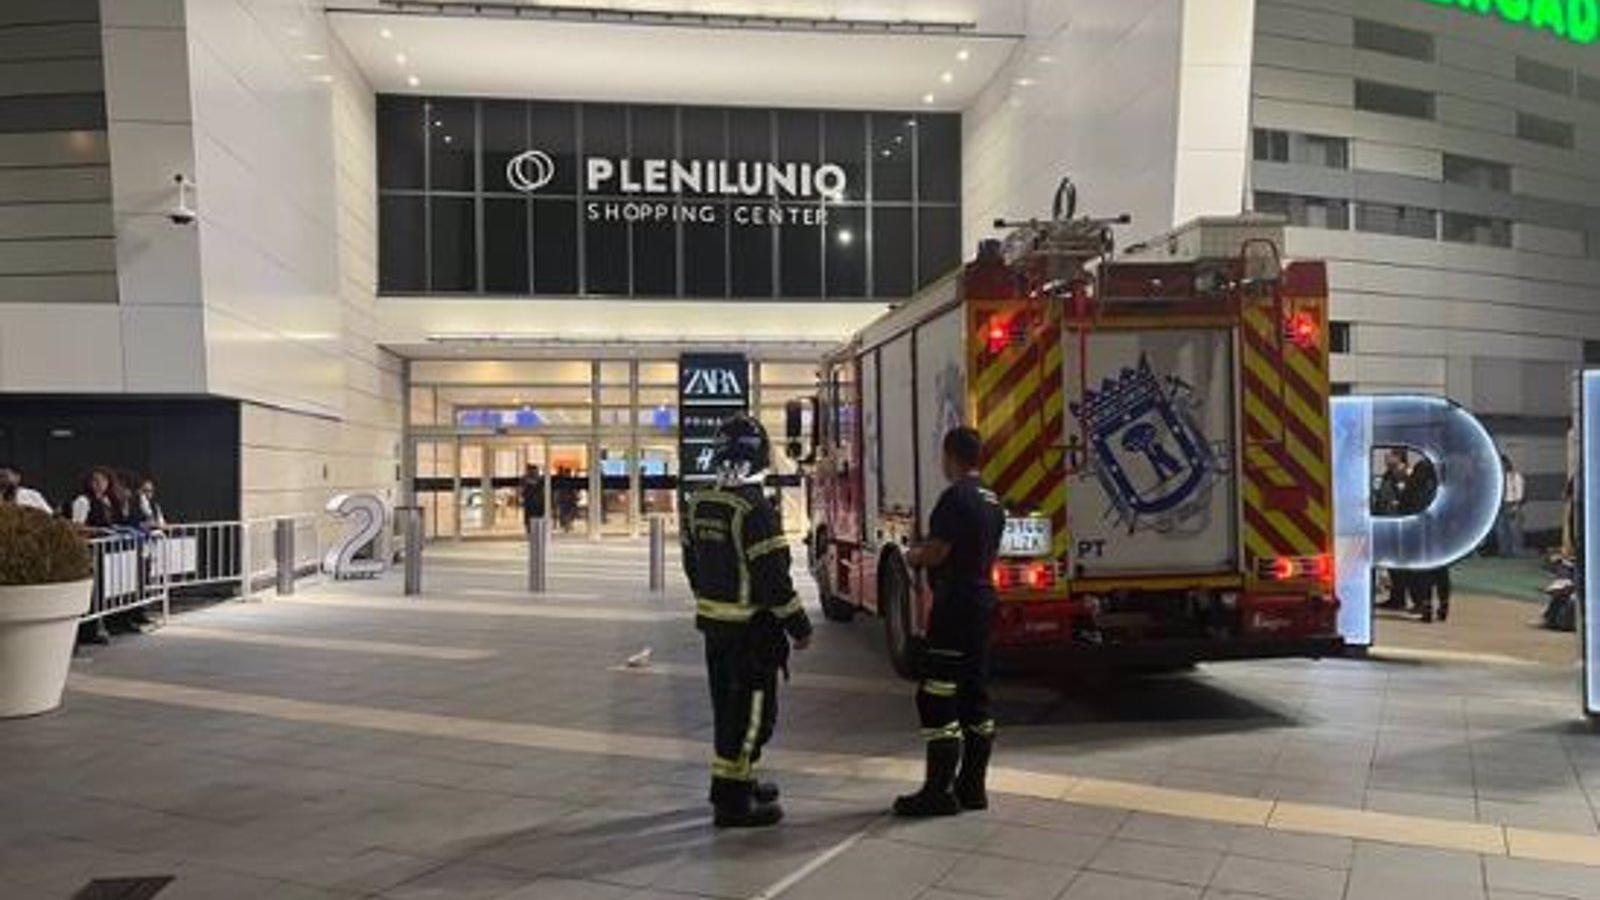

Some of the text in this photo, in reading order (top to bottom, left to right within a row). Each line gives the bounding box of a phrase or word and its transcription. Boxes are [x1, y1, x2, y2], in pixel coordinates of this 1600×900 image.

[587, 158, 847, 199] PLENILUNIO
[587, 203, 828, 226] SHOPPING CENTER
[684, 369, 741, 394] ZARA
[323, 493, 387, 580] 2
[1077, 539, 1106, 558] PT
